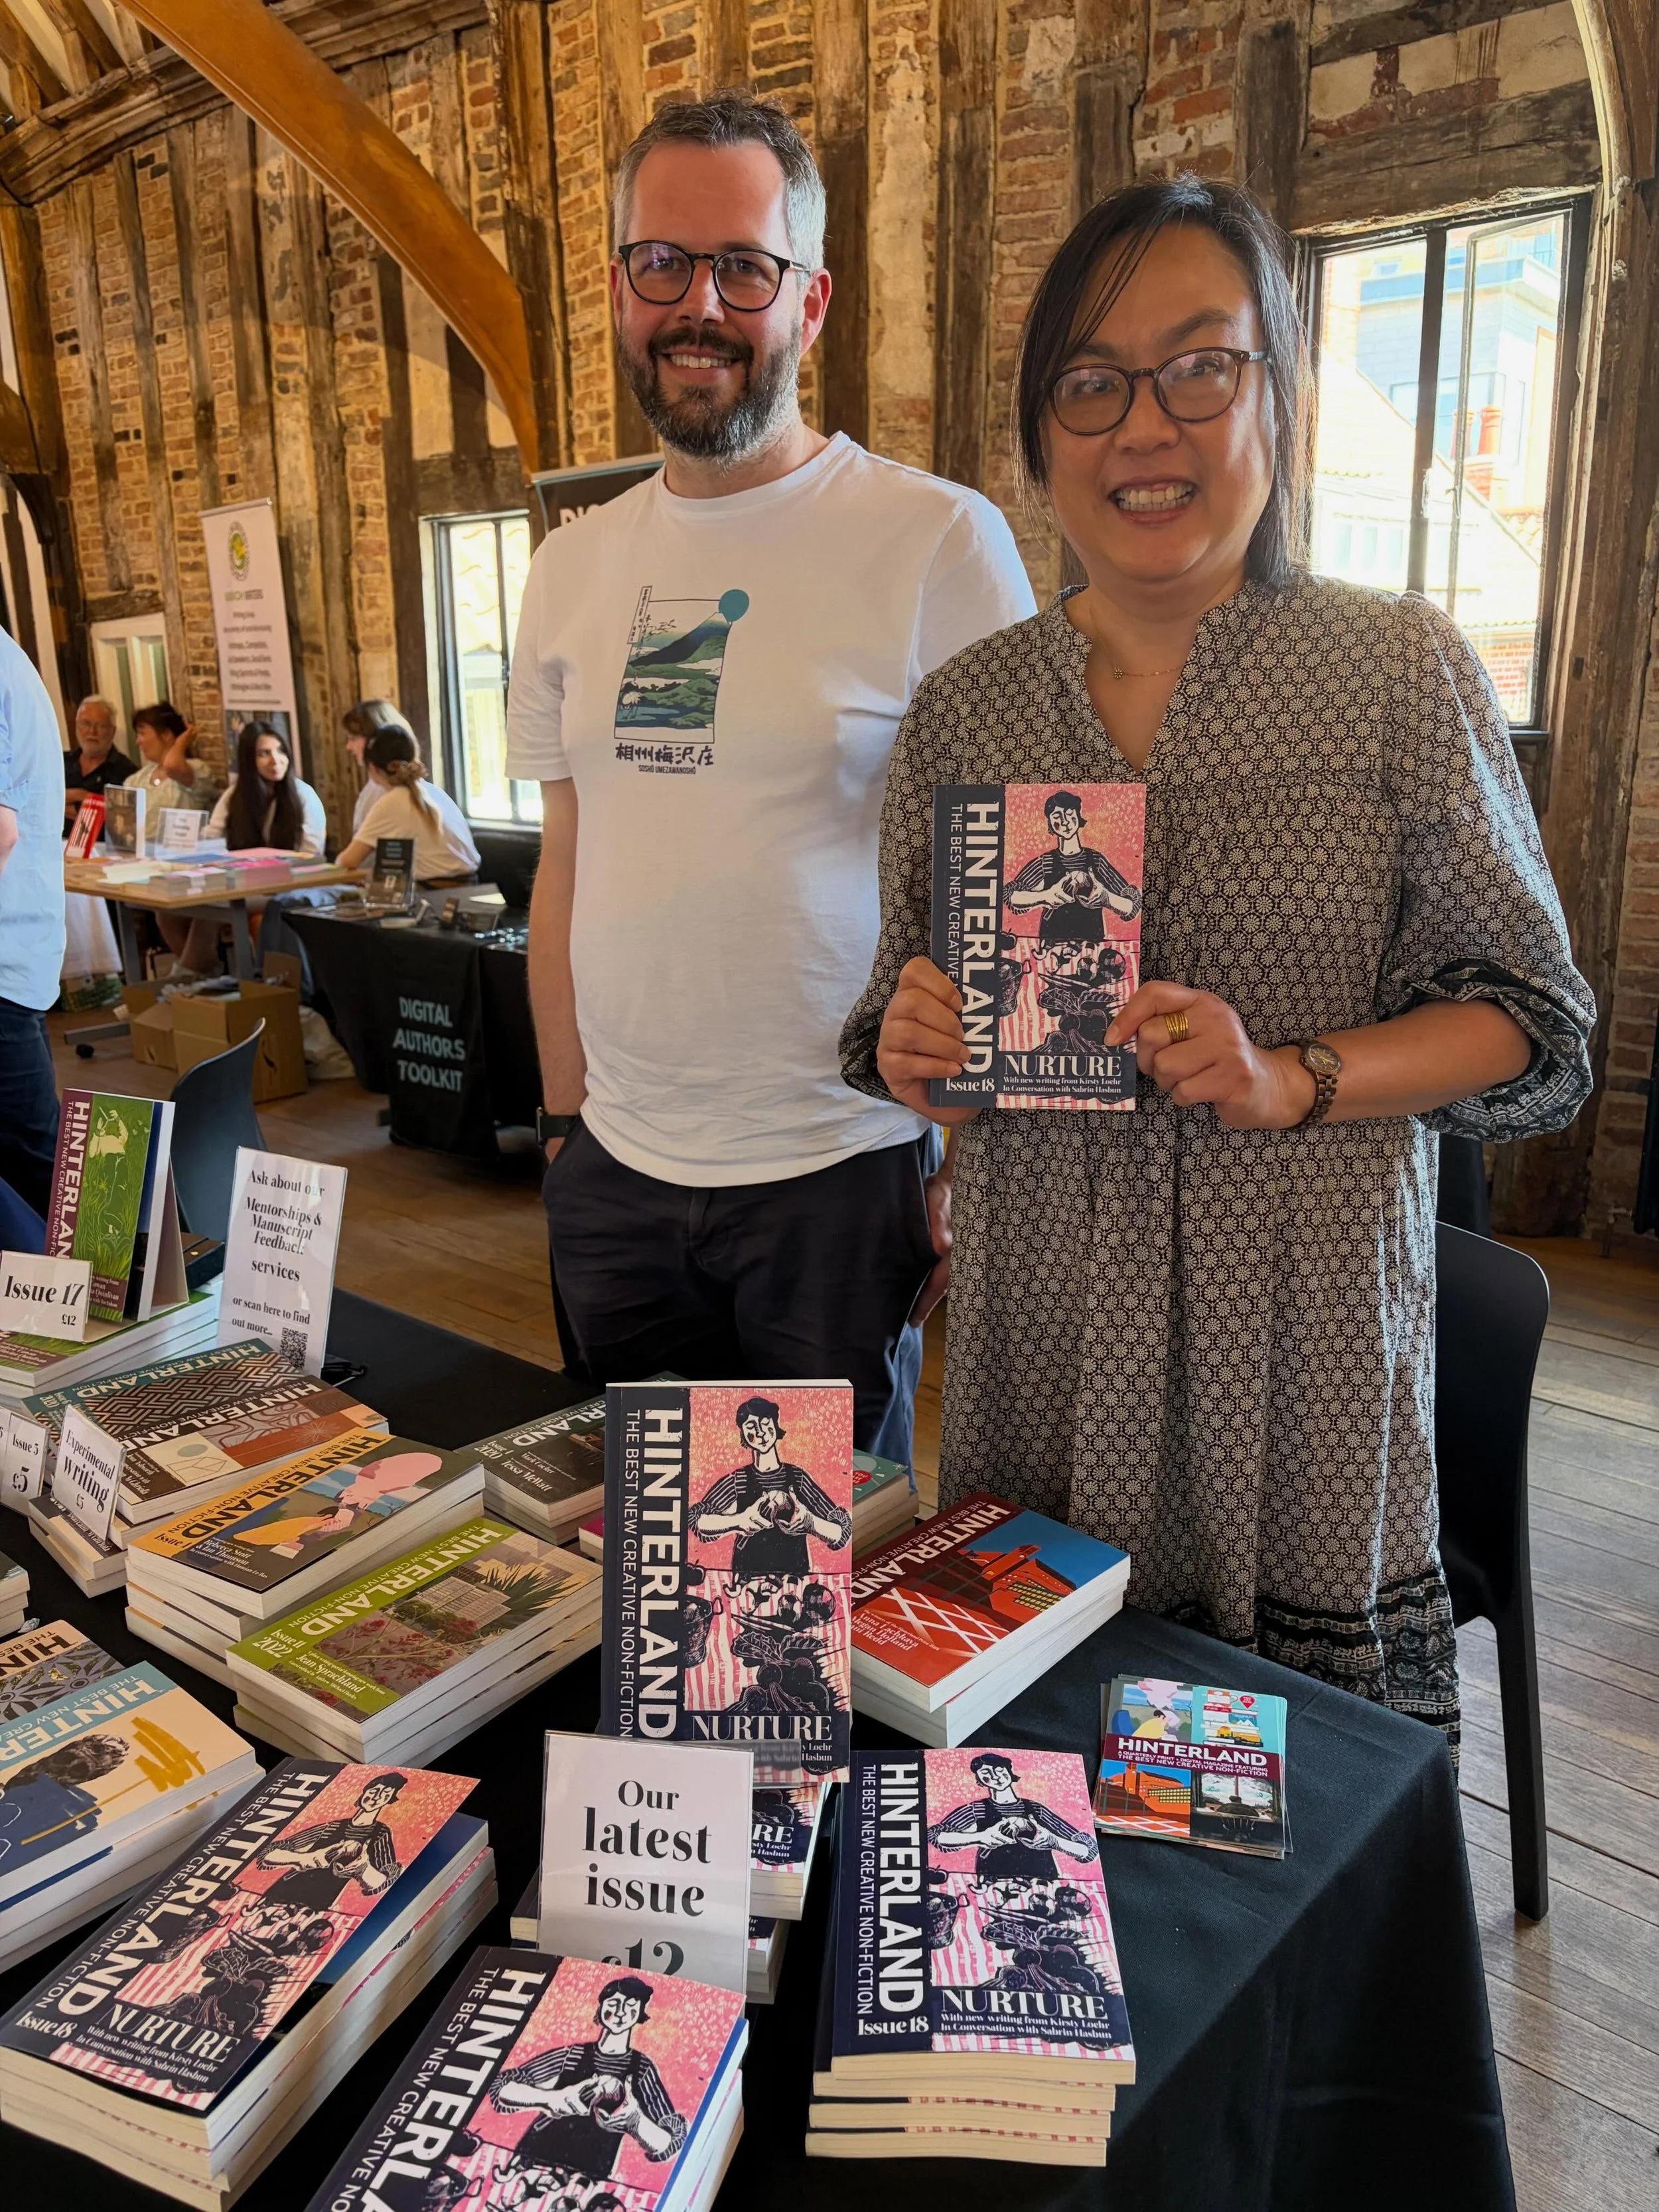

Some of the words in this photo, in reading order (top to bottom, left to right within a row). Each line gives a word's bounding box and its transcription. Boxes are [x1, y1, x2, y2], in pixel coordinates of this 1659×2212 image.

[616, 743, 714, 766] 相州梅沢庄
[950, 804, 962, 832] THE
[950, 837, 962, 871] BEST
[949, 877, 961, 908] NEW
[948, 912, 960, 982] CREATIVE
[962, 802, 999, 1073] HINTERLAND
[399, 996, 453, 1027] DIGITAL
[392, 1027, 466, 1060] AUTHORS
[397, 1059, 463, 1092] TOOLKIT
[1004, 1055, 1121, 1076] NURTURE
[946, 1078, 980, 1092] Issue
[982, 1078, 995, 1092] 18
[64, 1102, 74, 1121] THE
[62, 1122, 72, 1148] BEST
[60, 1148, 69, 1169] NEW
[55, 1171, 67, 1215] CREATIVE
[56, 1101, 90, 1258] HINTERLAN
[248, 1169, 268, 1186] Ask
[271, 1174, 301, 1193] about
[244, 1196, 312, 1228] Mentorships
[313, 1212, 322, 1226] &
[250, 1214, 313, 1241] Manuscript
[251, 1259, 300, 1282] services
[4, 1276, 57, 1303] Issue
[60, 1283, 85, 1306] 17
[62, 1313, 77, 1325] £12
[231, 1317, 245, 1328] out
[233, 1297, 243, 1305] or
[244, 1299, 261, 1312] scan
[263, 1301, 281, 1317] here
[283, 1307, 291, 1319] to
[293, 1310, 311, 1325] find
[76, 1345, 261, 1398] HINTERLAND
[345, 1434, 362, 1445] THE
[503, 1415, 563, 1440] NON-FICTION
[626, 1410, 640, 1445] THE
[12, 1434, 33, 1453] Issue
[33, 1443, 39, 1455] 5
[66, 1429, 116, 1480] Experimental
[314, 1443, 341, 1459] BEST
[488, 1440, 508, 1452] Issue
[12, 1465, 30, 1493] £5
[290, 1459, 312, 1471] NEW
[624, 1451, 639, 1492] BEST
[63, 1455, 109, 1513] Writing
[181, 1435, 386, 1539] HINTERLAND
[238, 1467, 290, 1500] CREATIVE
[76, 1493, 85, 1510] £5
[167, 1493, 243, 1534] NON-FICTION
[622, 1495, 638, 1534] NEW
[950, 1509, 971, 1522] BEST
[973, 1500, 987, 1510] THE
[154, 1532, 184, 1546] Issue
[461, 1526, 481, 1538] THE
[927, 1521, 950, 1534] NEW
[204, 1538, 234, 1555] Rebecca
[232, 1548, 252, 1560] Stott
[215, 1548, 250, 1566] Thomson
[410, 1550, 436, 1564] NEW
[435, 1534, 460, 1552] BEST
[851, 1503, 1011, 1599] HINTERLAND
[890, 1531, 930, 1558] CREATIVE
[301, 1527, 503, 1636] HINTERLAND
[365, 1560, 411, 1588] CREATIVE
[621, 1538, 638, 1621] CREATIVE
[638, 1408, 683, 1739] HINTERLAND
[289, 1582, 365, 1629] NON-FICTION
[859, 1613, 880, 1627] Anna
[252, 1636, 293, 1659] 2022
[270, 1629, 297, 1644] Issue
[851, 1615, 877, 1633] Megan
[876, 1629, 914, 1651] Holland
[863, 1631, 888, 1646] Redd
[109, 1676, 139, 1690] THE
[295, 1654, 317, 1669] Jean
[315, 1663, 366, 1693] Sprackland
[619, 1625, 636, 1737] NON-FICTION
[74, 1688, 108, 1708] BEST
[0, 1680, 164, 1761] HINTER
[36, 1706, 70, 1725] NEW
[691, 1715, 833, 1741] NURTURE
[1118, 1737, 1267, 1767] HINTERLAND
[265, 1772, 296, 1795] THE
[862, 1765, 876, 1786] THE
[1176, 1761, 1214, 1771] CREATIVE
[1216, 1765, 1268, 1777] NON-FICTION
[618, 1780, 680, 1810] Our
[862, 1789, 876, 1818] BEST
[235, 1795, 267, 1826] BEST
[202, 1827, 238, 1856] NEW
[582, 1806, 712, 1864] latest
[861, 1820, 875, 1850] NEW
[58, 1773, 330, 2016] HINTERLAND
[133, 1856, 204, 1917] CREATIVE
[584, 1862, 705, 1917] issue
[859, 1852, 875, 1913] CREATIVE
[879, 1762, 925, 2014] HINTERLAND
[35, 1919, 139, 2008] NON-FICTION
[857, 1916, 875, 2015] NON-FICTION
[469, 1967, 500, 2000] THE
[941, 1989, 1108, 2020] NURTURE
[16, 2010, 57, 2035] Issue
[52, 2020, 78, 2039] 18
[96, 2003, 241, 2063] NURTURE
[441, 2002, 478, 2046] BEST
[858, 2019, 908, 2036] Issue
[910, 2015, 929, 2033] 18
[941, 2014, 963, 2022] With
[987, 2016, 1023, 2026] writing
[1025, 2016, 1047, 2027] from
[952, 2024, 1015, 2034] Conversation
[1017, 2026, 1039, 2035] with
[413, 2047, 449, 2089] NEW
[350, 2091, 419, 2181] CREATIVE
